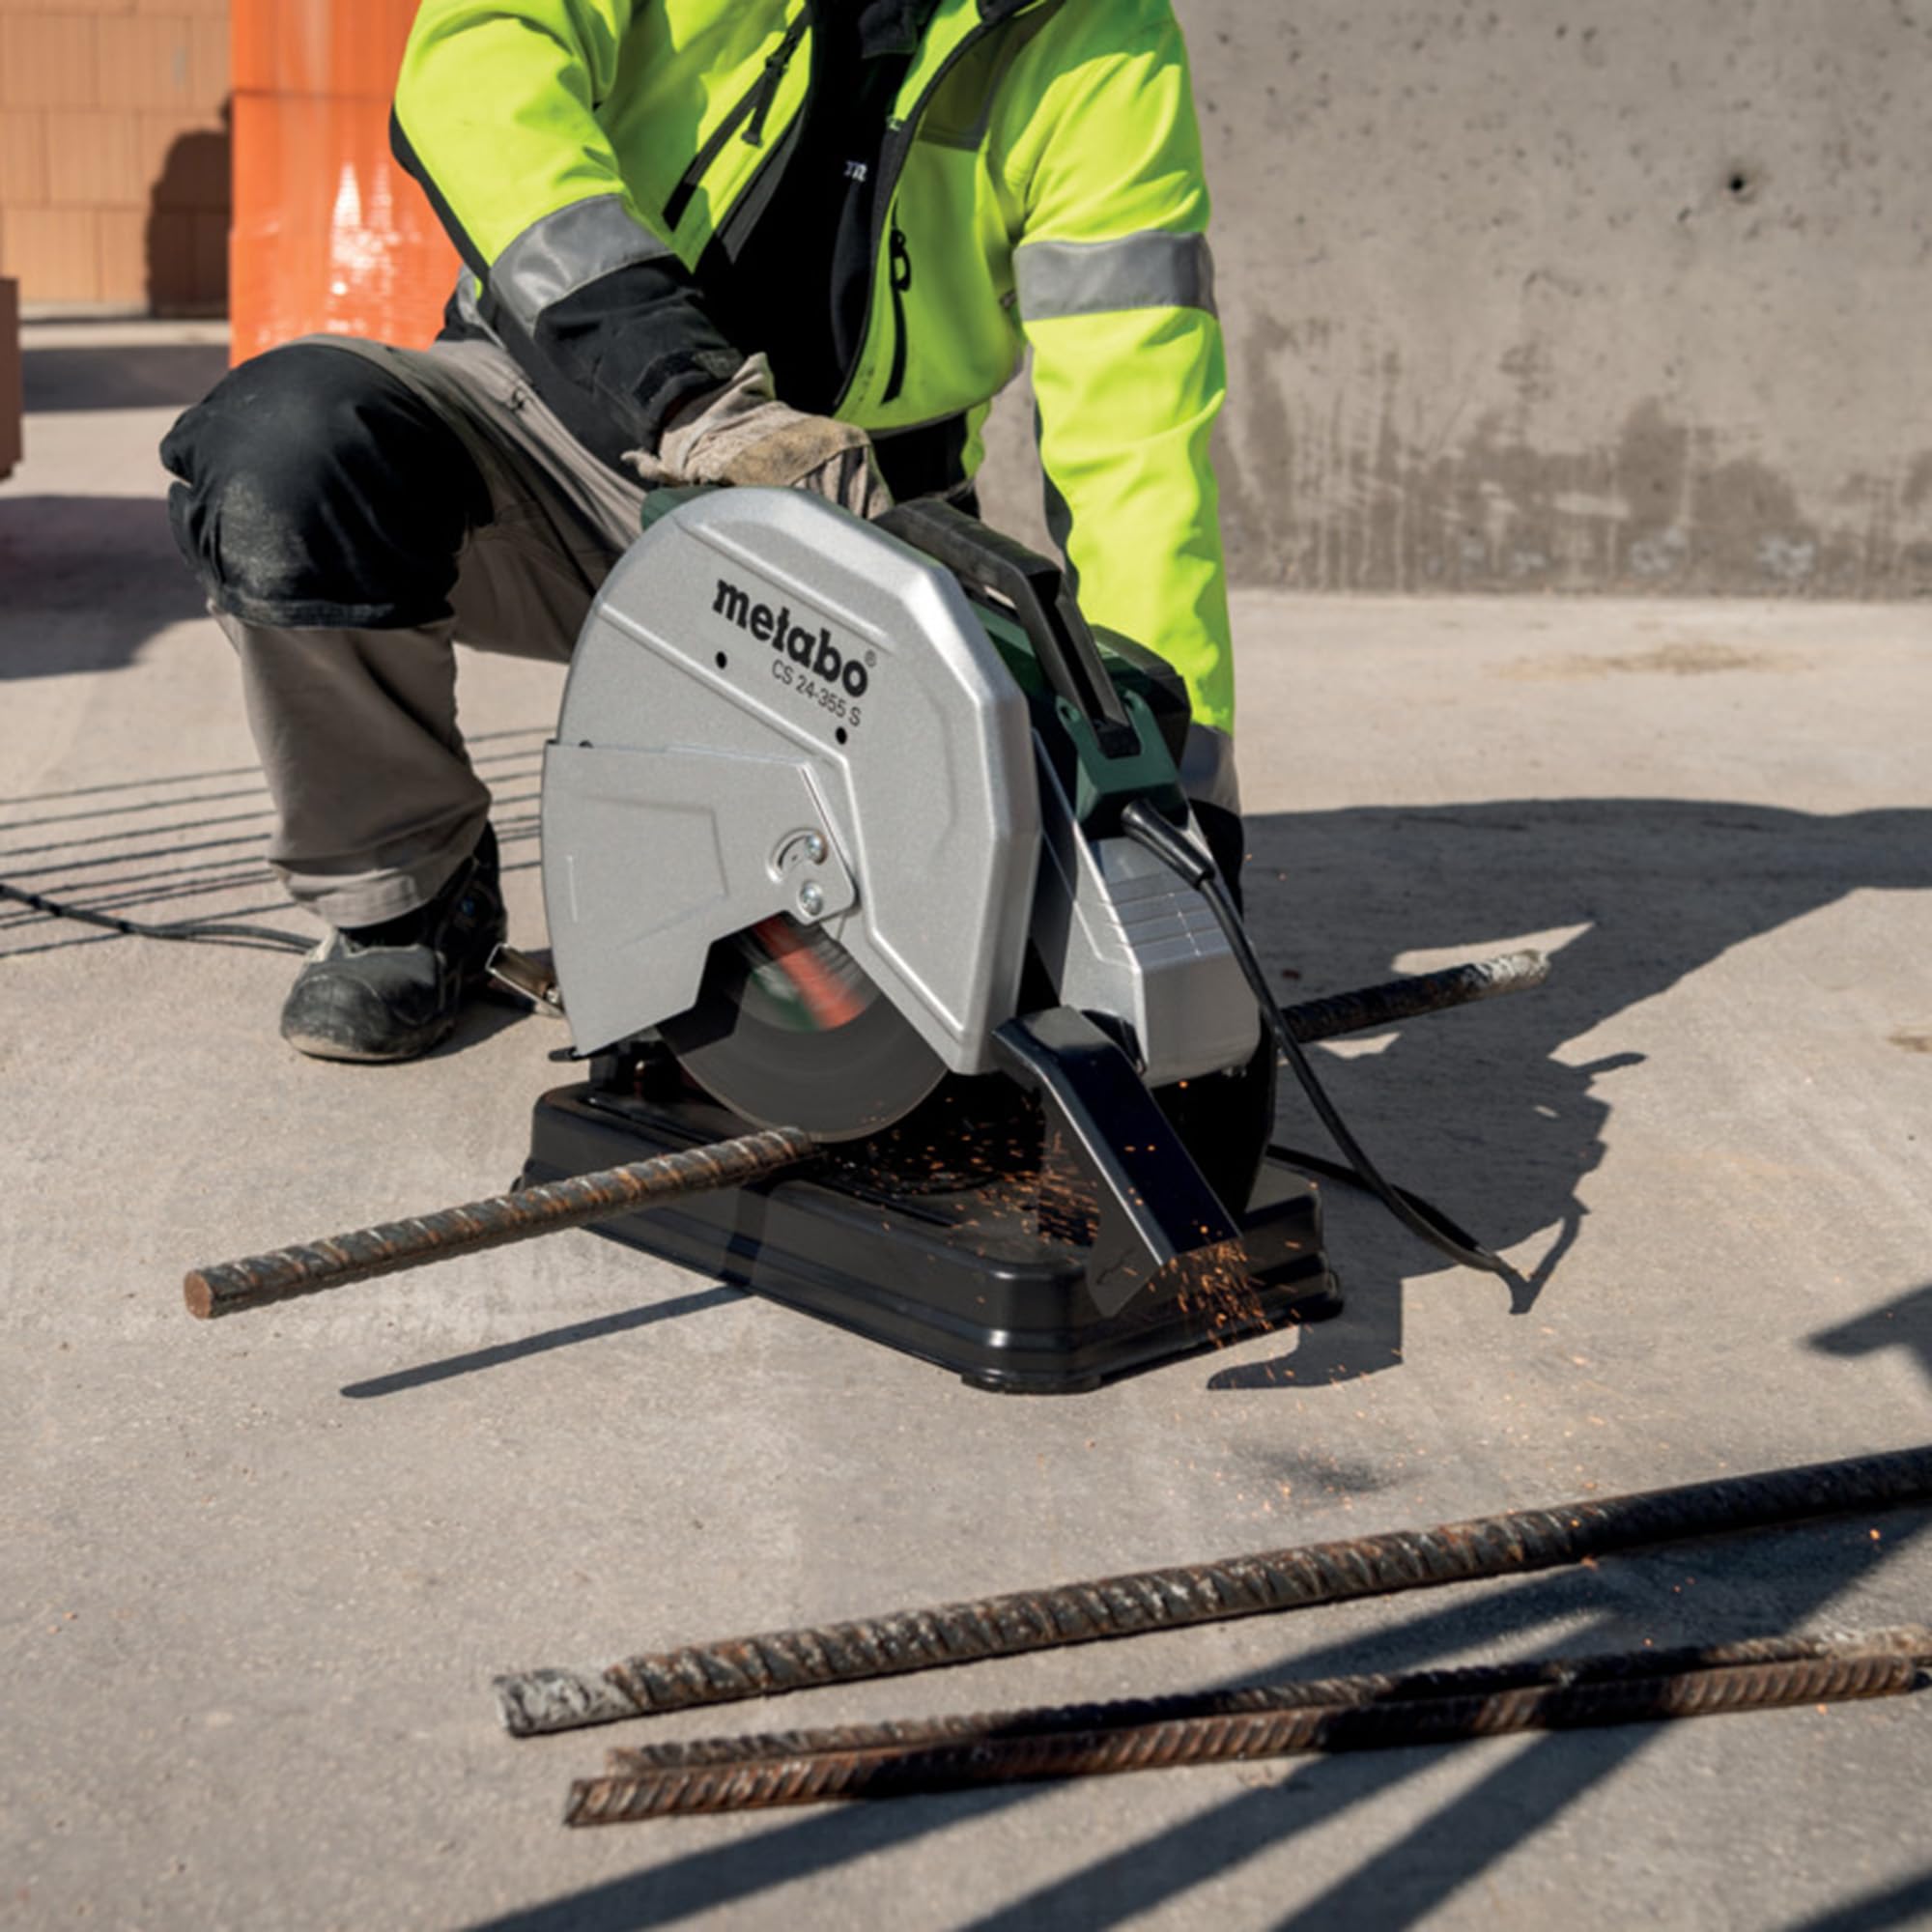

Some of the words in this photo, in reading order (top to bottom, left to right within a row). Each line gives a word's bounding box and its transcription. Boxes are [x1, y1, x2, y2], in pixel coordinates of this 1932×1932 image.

[712, 580, 868, 697] metabo
[772, 659, 793, 685] CS
[795, 675, 847, 718] 24-355
[848, 706, 862, 726] S
